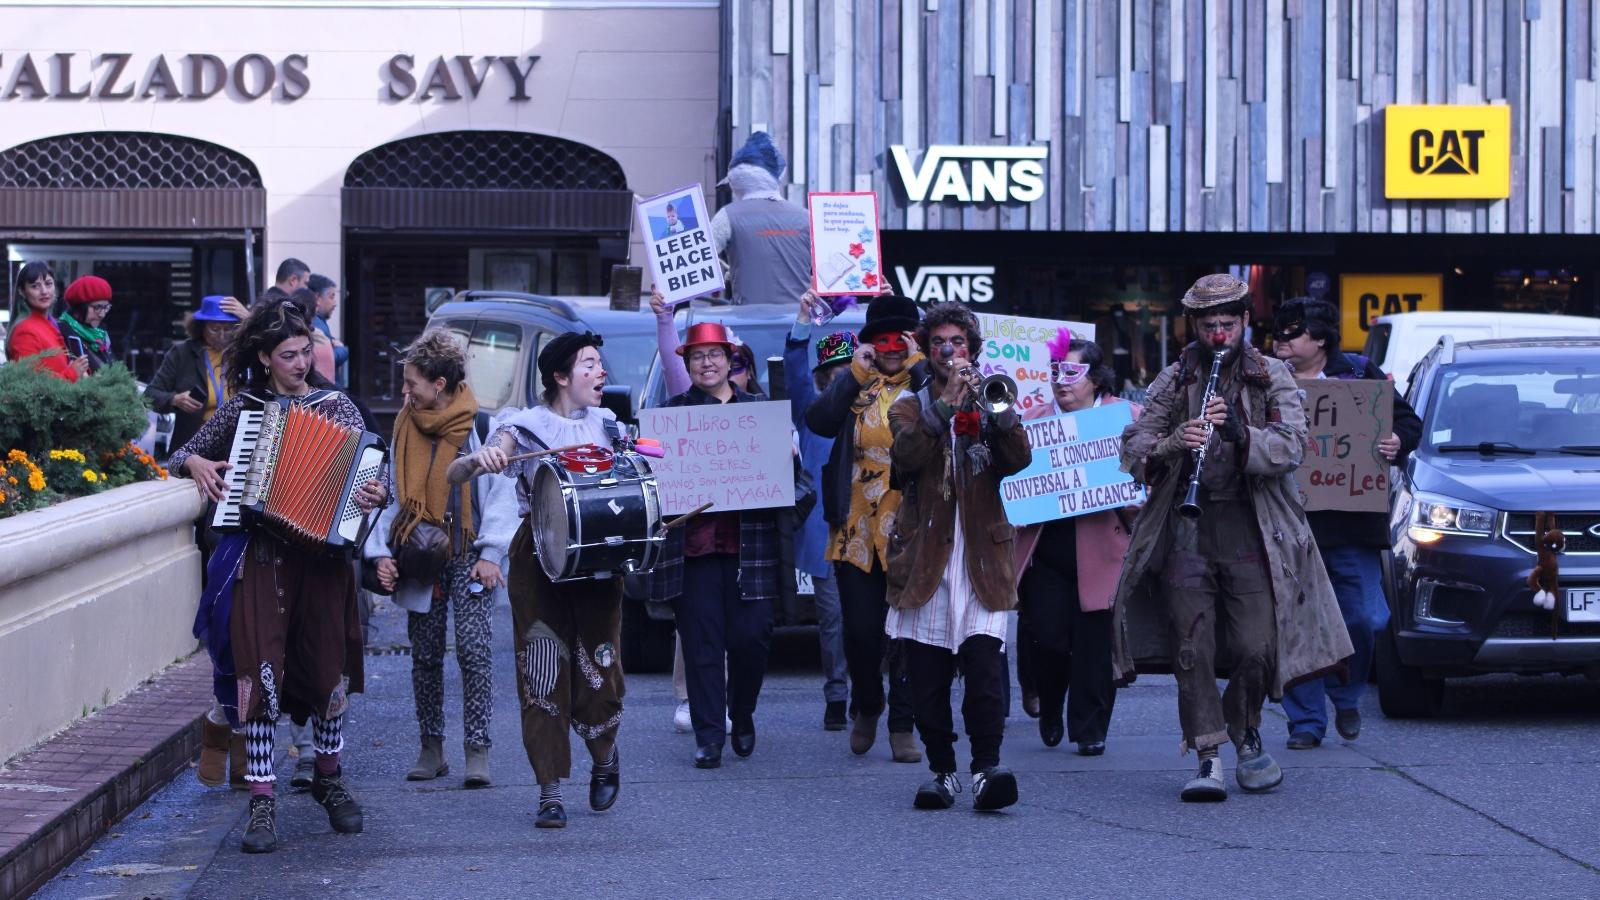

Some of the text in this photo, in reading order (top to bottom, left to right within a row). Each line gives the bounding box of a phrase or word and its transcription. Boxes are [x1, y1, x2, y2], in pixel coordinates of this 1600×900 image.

[0, 53, 541, 101] ALZADOS SAVY
[1410, 129, 1485, 175] CAT
[890, 145, 1048, 202] VANS
[656, 230, 707, 257] LEER
[659, 247, 713, 274] HACE
[667, 266, 715, 291] BIEN
[895, 266, 996, 302] VANS
[986, 340, 1030, 362] SON
[653, 413, 679, 435] UN
[738, 415, 758, 430] ES
[677, 438, 740, 456] PRUEBA
[747, 436, 761, 453] de
[1050, 448, 1061, 468] EL
[710, 458, 752, 472] SERES
[1003, 469, 1082, 501] UNIVERSAL A
[1058, 481, 1137, 514] TU ALCANCE
